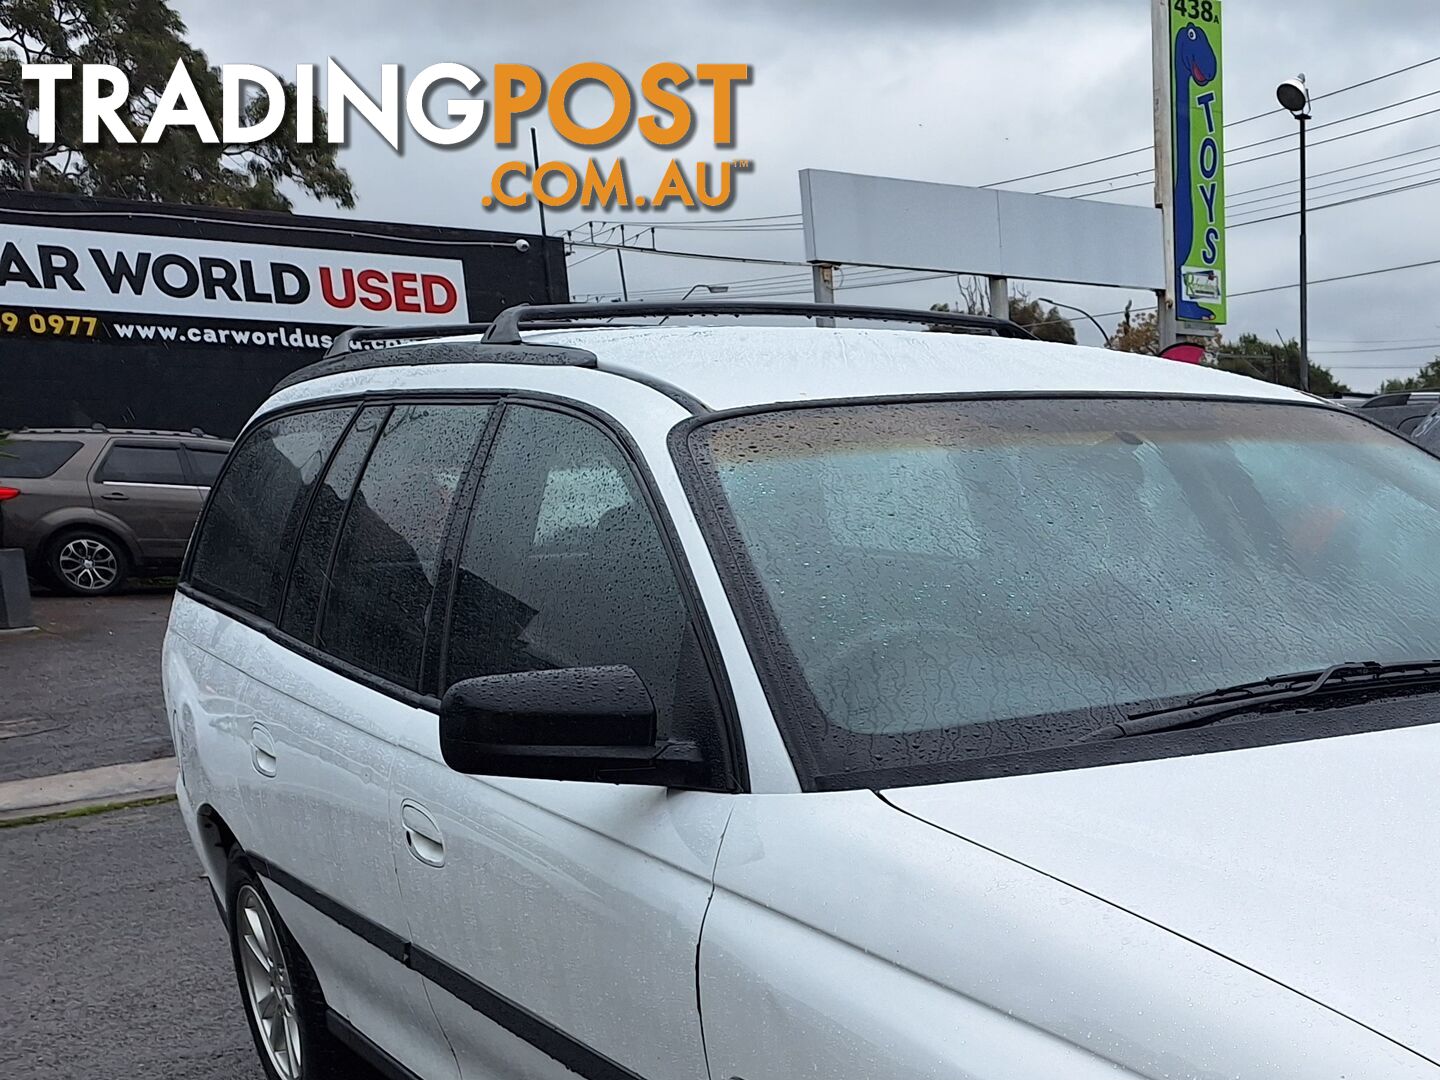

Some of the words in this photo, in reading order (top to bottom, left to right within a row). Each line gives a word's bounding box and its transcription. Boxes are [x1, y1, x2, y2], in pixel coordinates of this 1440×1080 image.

[1196, 91, 1220, 265] TOYS
[88, 247, 310, 305] WORLD
[318, 265, 458, 314] USED
[29, 313, 97, 336] 0977
